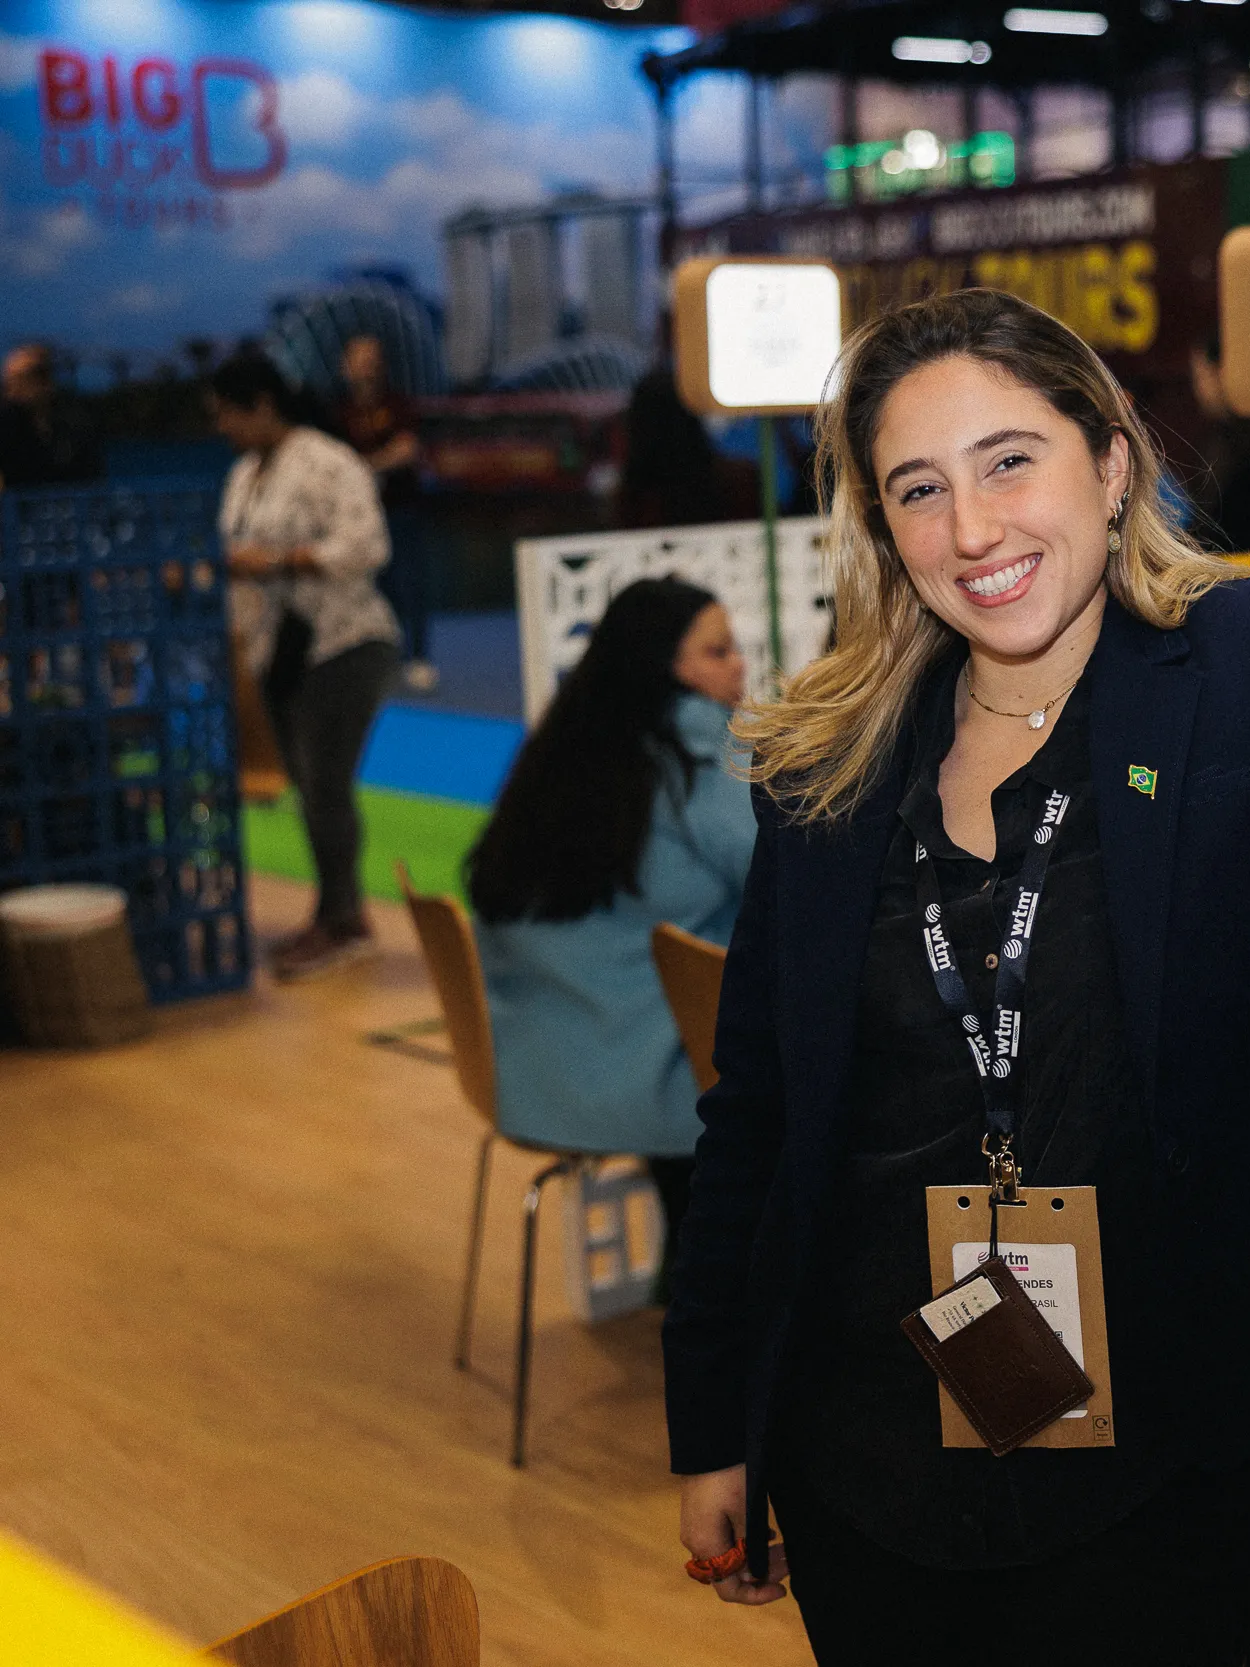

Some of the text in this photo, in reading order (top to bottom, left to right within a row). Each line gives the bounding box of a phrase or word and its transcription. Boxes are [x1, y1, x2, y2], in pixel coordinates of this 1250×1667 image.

[41, 49, 183, 134] BIG
[1010, 891, 1033, 936] wtm
[931, 923, 952, 970] wtm
[994, 1009, 1013, 1056] wtm
